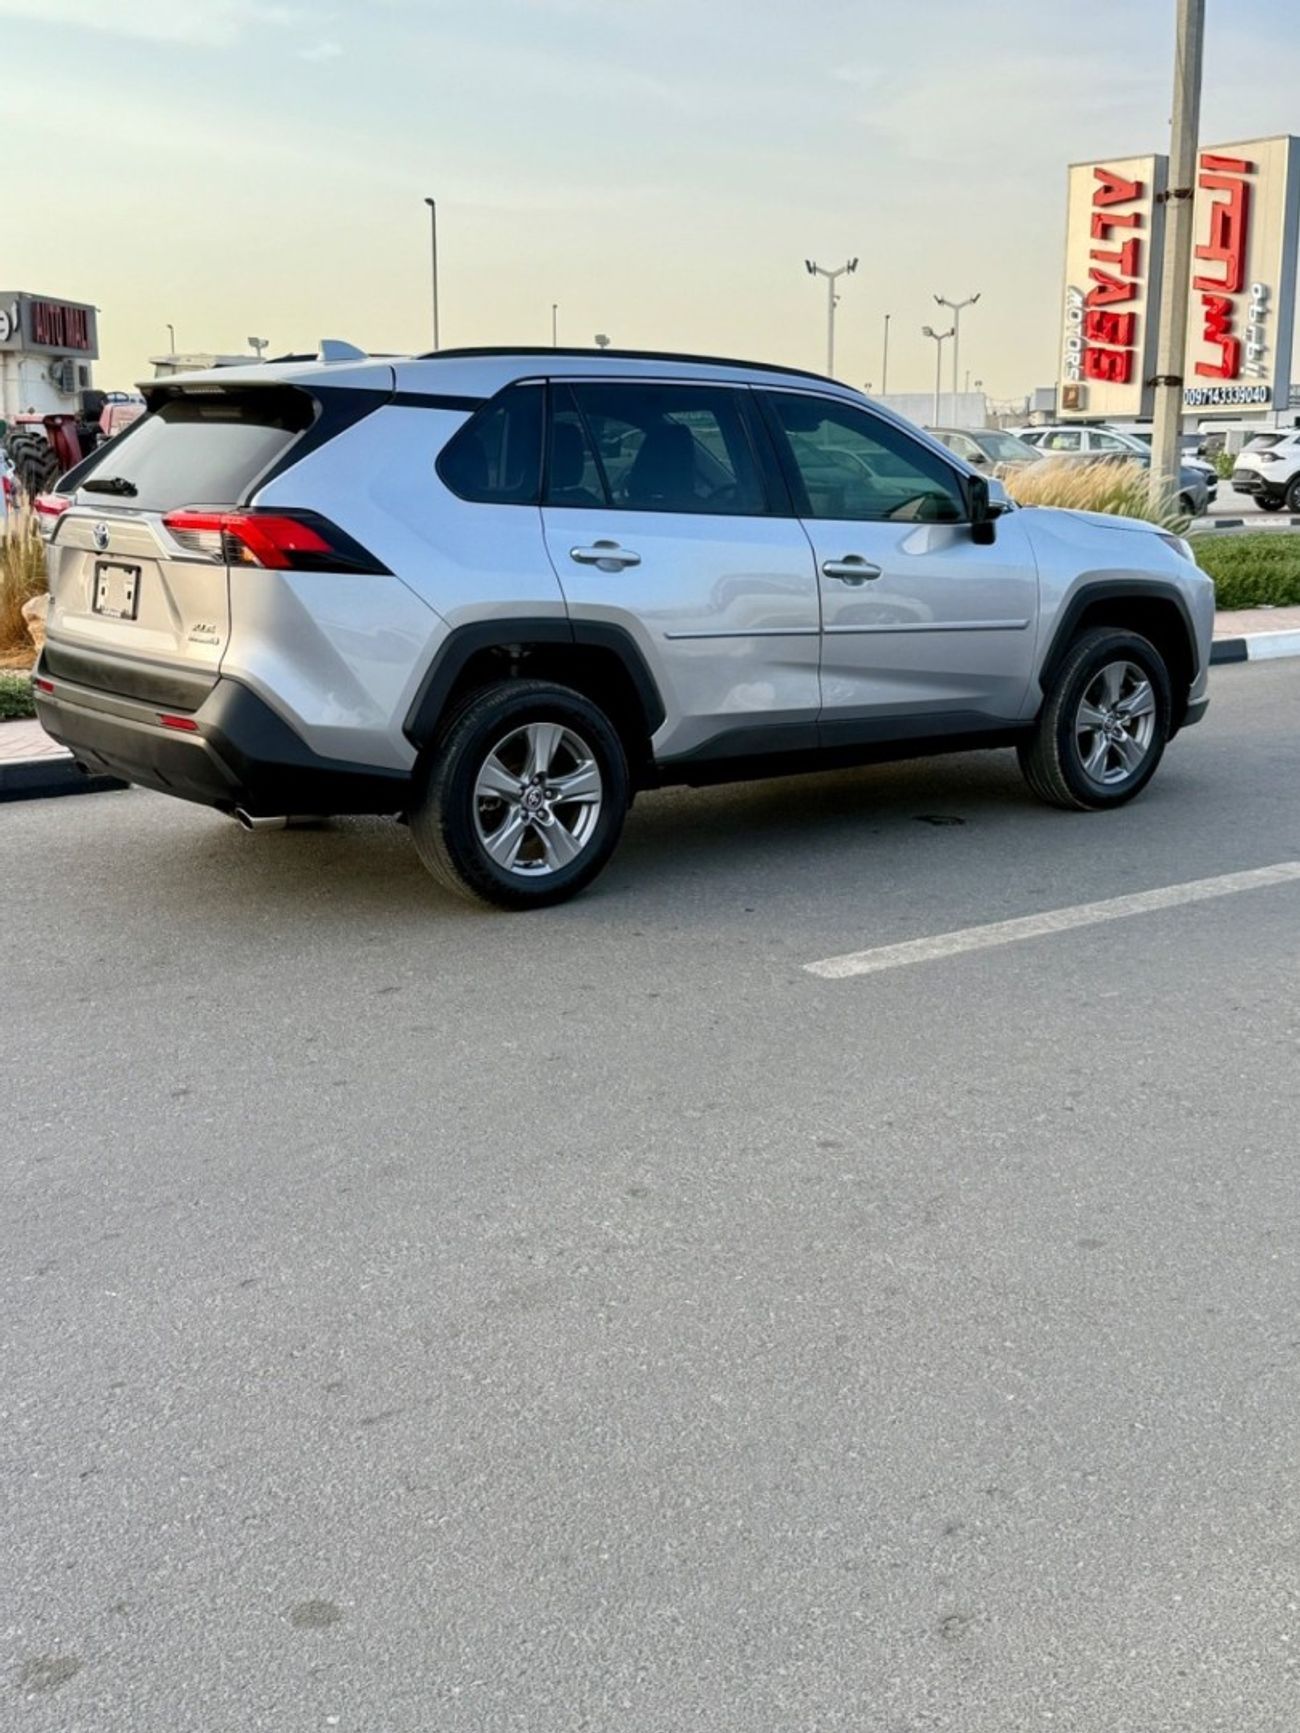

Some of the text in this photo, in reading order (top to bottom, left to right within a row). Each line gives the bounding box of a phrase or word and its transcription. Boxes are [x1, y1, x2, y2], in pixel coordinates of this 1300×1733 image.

[1193, 153, 1253, 379] الطاس
[35, 302, 63, 345] AUTO
[1065, 285, 1084, 380] MOTORS
